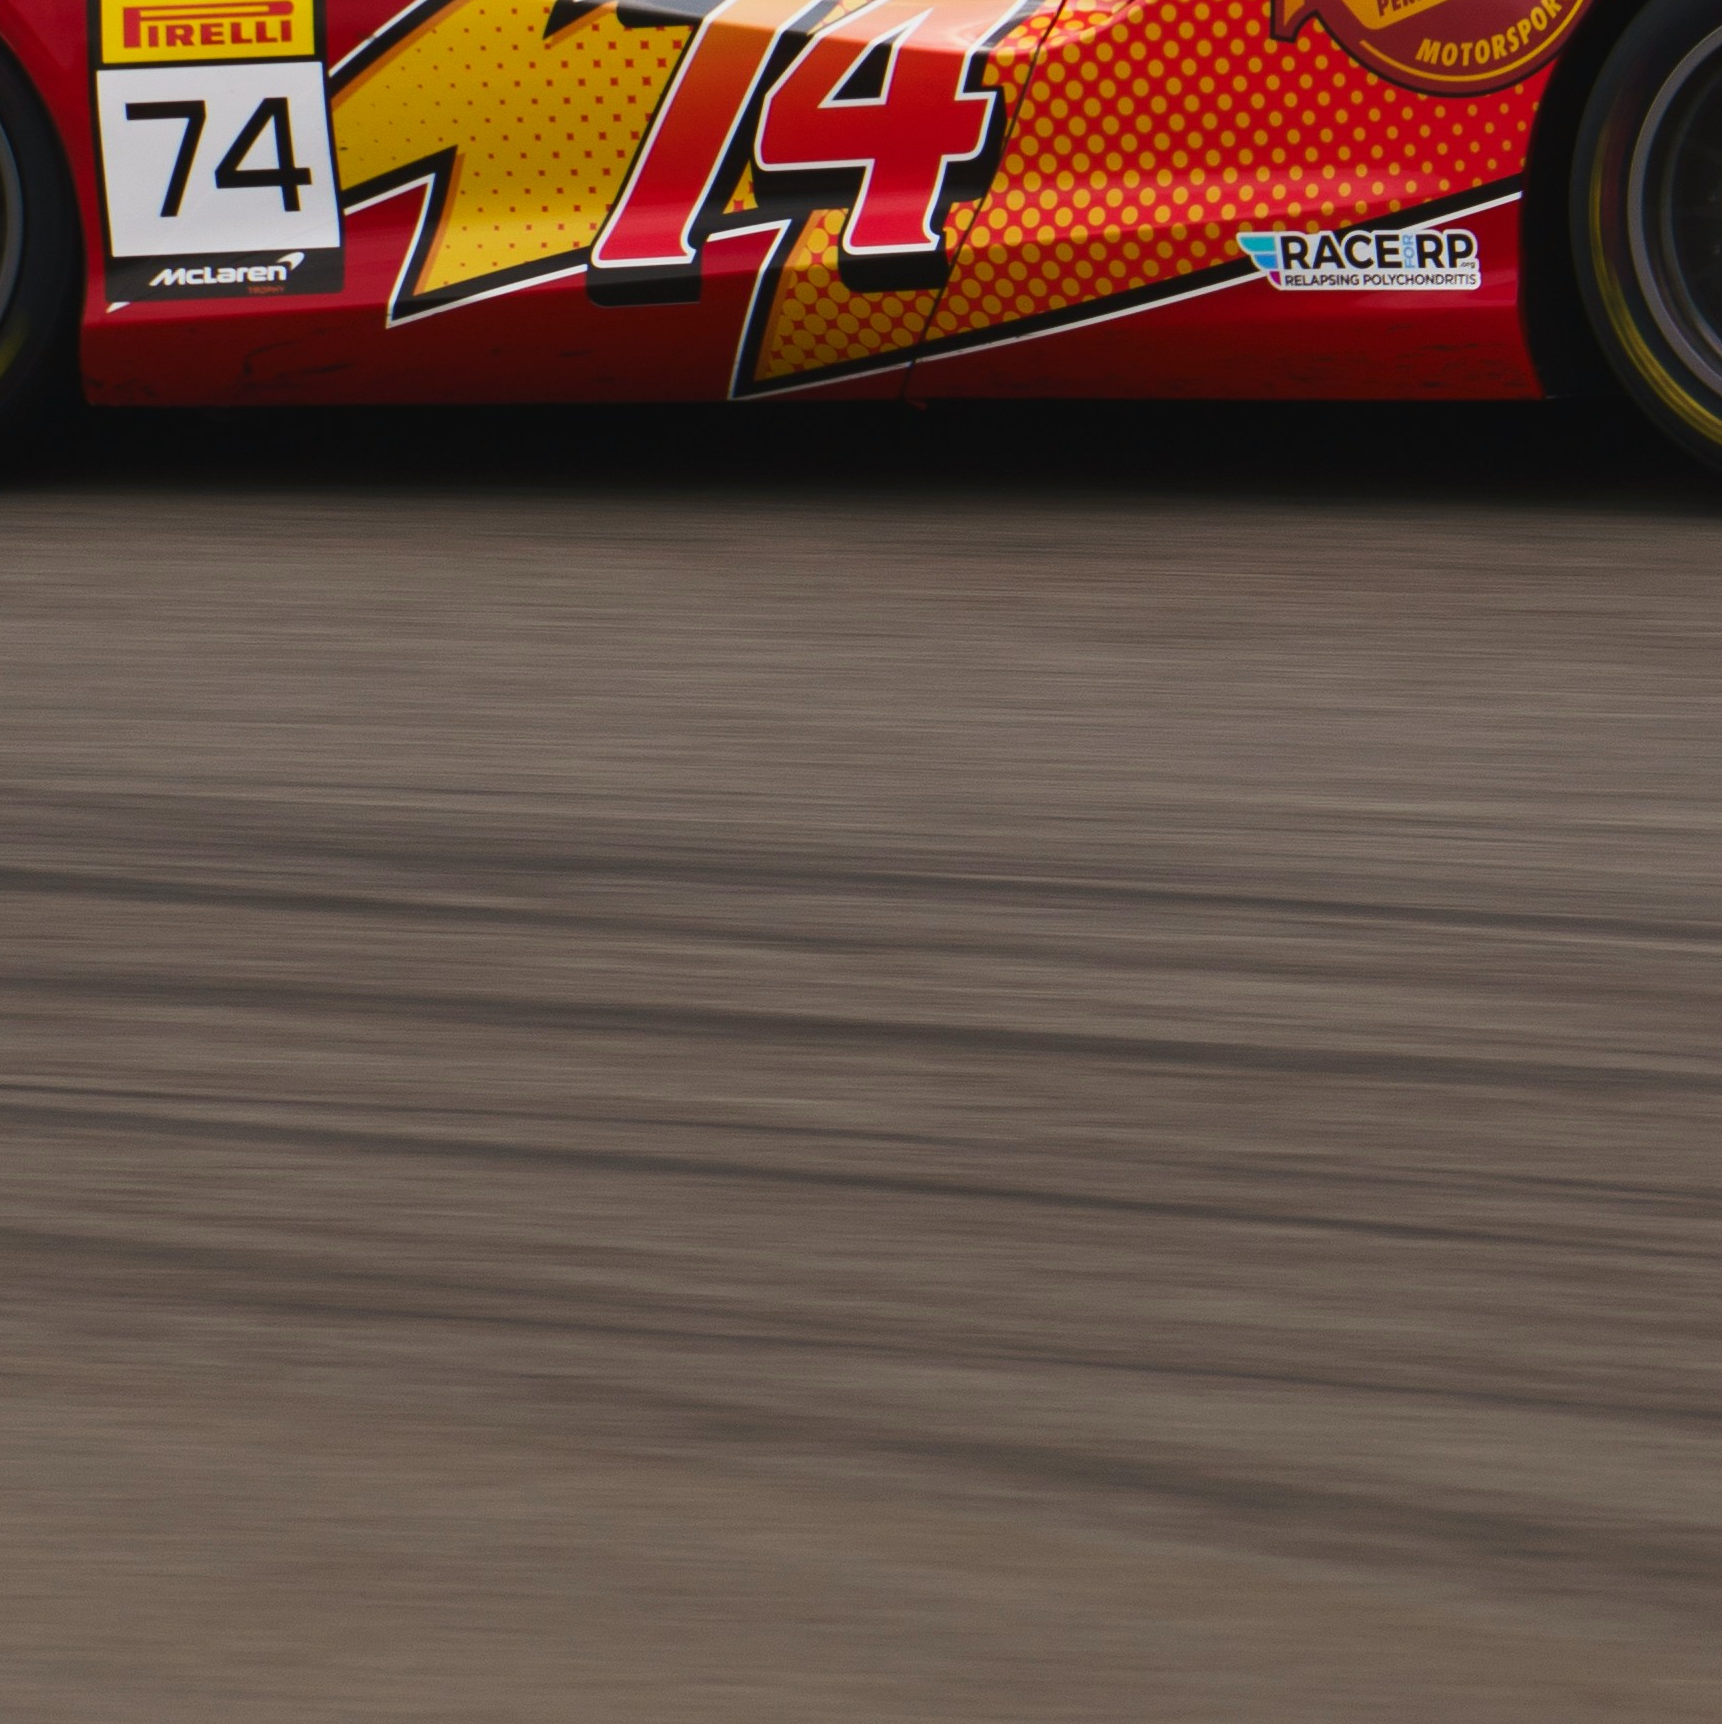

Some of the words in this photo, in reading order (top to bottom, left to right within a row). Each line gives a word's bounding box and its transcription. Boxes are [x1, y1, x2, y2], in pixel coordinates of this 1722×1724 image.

[122, 0, 294, 49] PIRELLI
[123, 96, 314, 219] 74
[1279, 233, 1403, 270] RACE
[1415, 233, 1475, 269] RP
[148, 263, 288, 287] McLaren
[1284, 273, 1360, 287] RELAPSING
[1363, 272, 1477, 286] POLYCHONDRITIS
